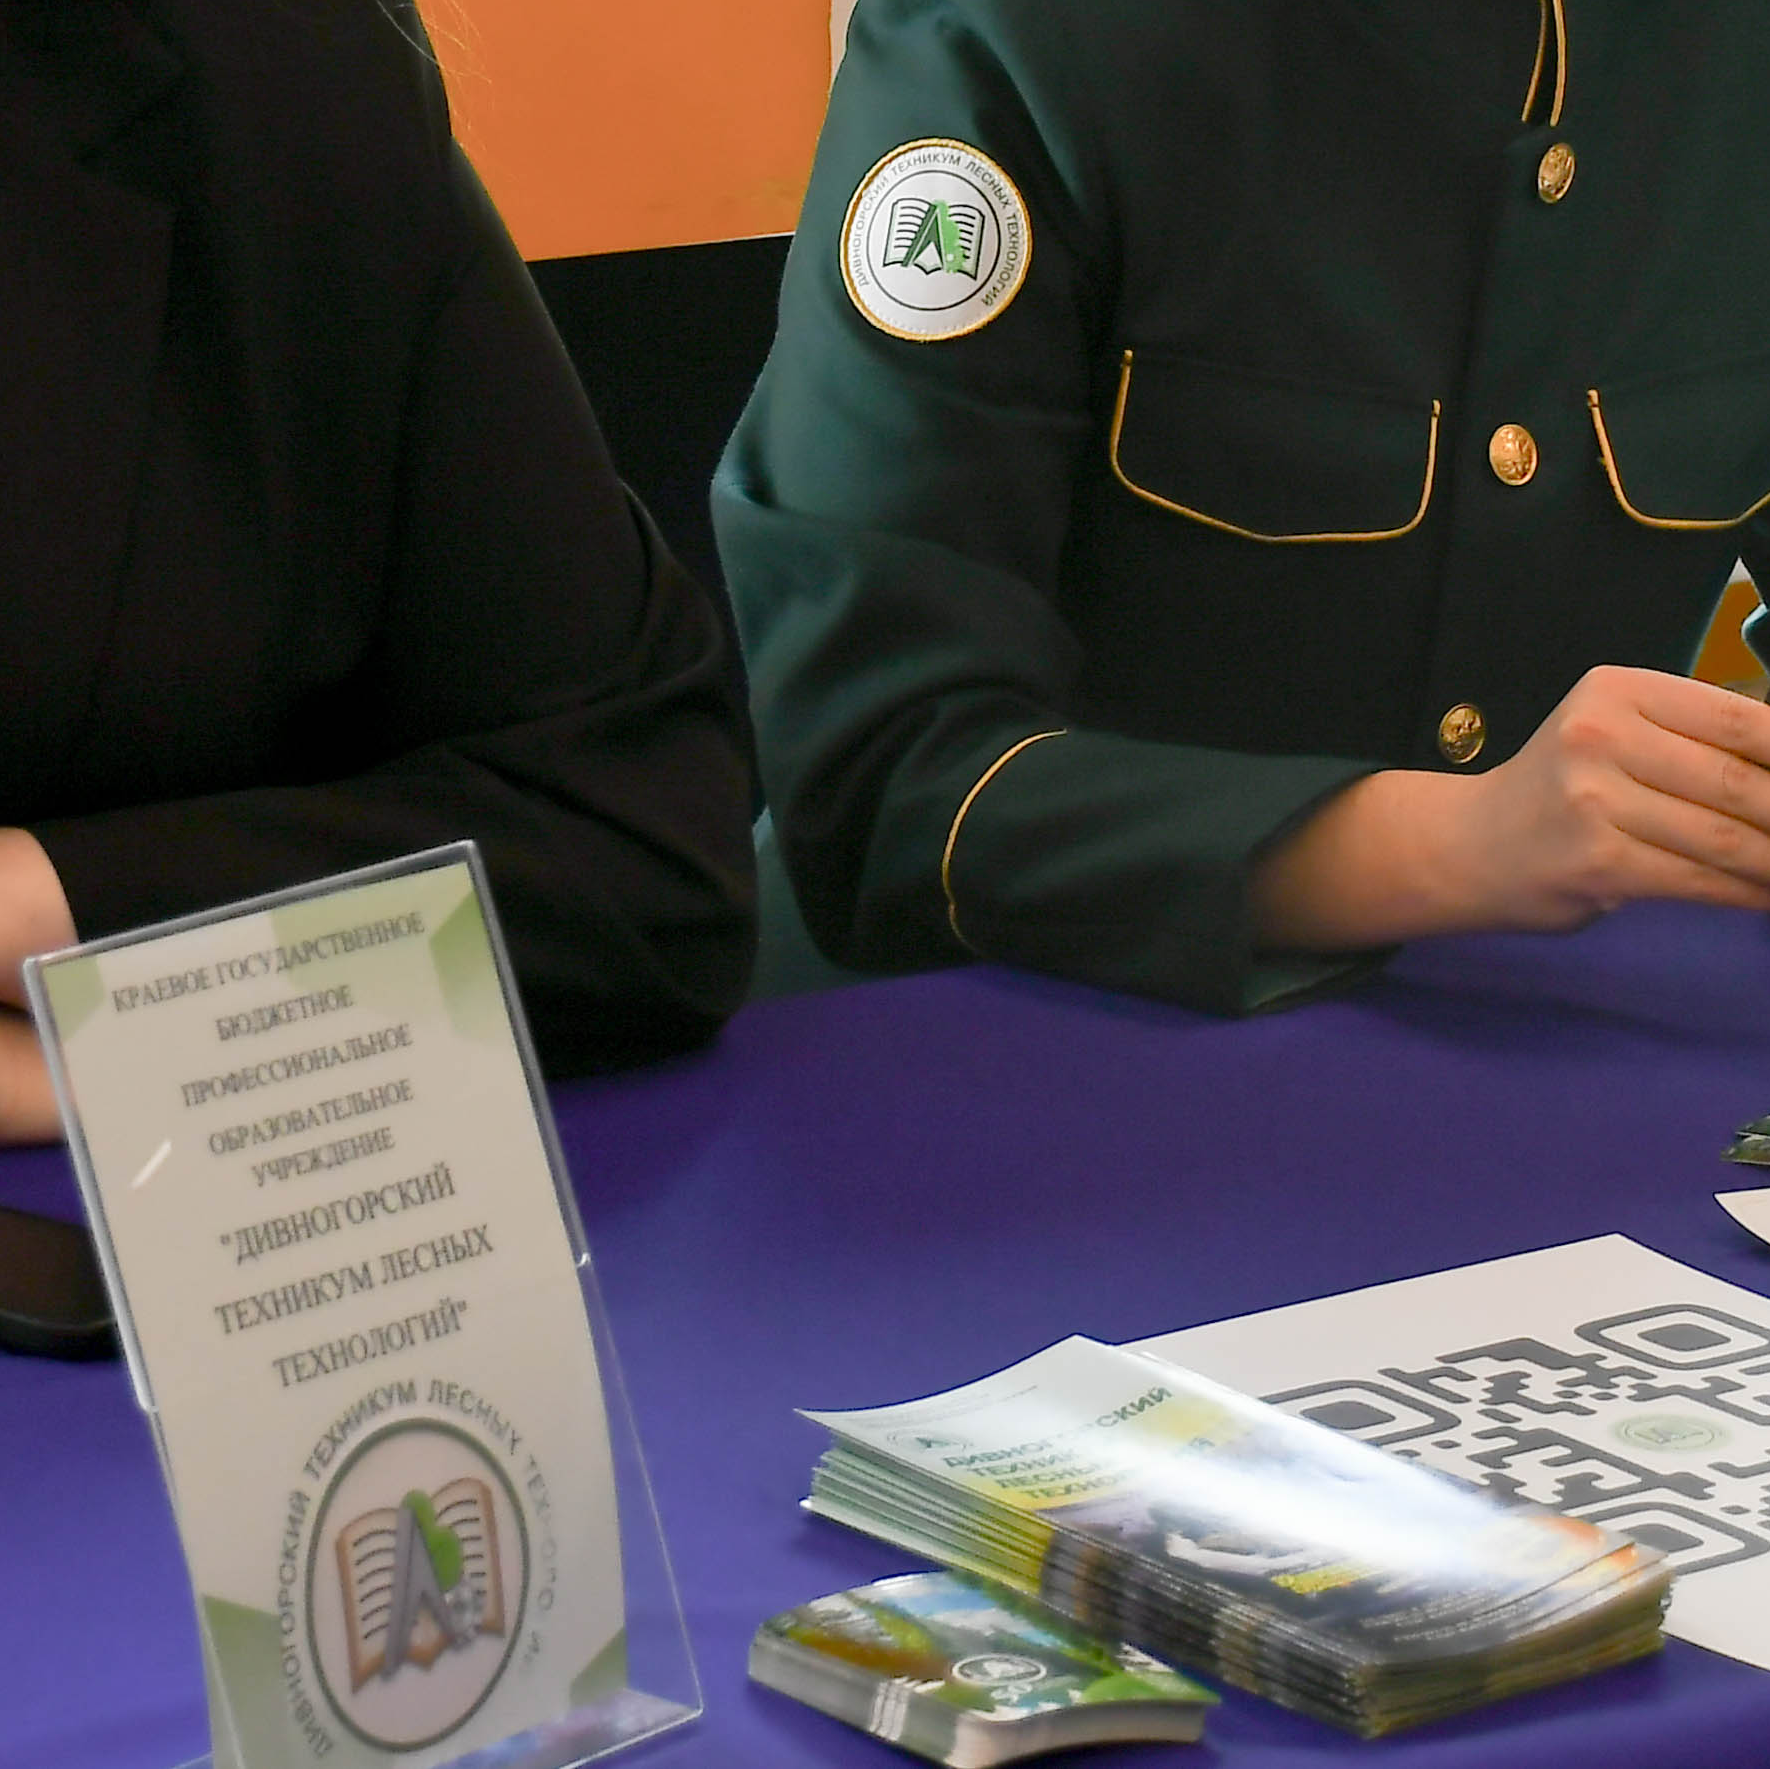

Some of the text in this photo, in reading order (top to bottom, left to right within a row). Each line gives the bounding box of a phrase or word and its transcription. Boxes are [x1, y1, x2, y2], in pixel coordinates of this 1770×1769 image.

[890, 152, 962, 178] ТЕХНИКУМ
[964, 160, 1012, 210] ЛЕСНЫХ
[111, 911, 425, 1013] КРАЕВОЕ ГОСУДАРСТВЕННОЕ
[215, 984, 354, 1042] БЮДЖЕТНОЕ
[181, 1023, 414, 1108] ПРОФЕССИОНАЛЬНОЕ
[208, 1079, 414, 1156] ОБРАЗОВАТЕЛЬНОЕ
[250, 1127, 396, 1190] УЧРЕЖДЕНИЕ
[219, 1162, 457, 1266] "ДИВНОГОРСКИЙ
[214, 1224, 495, 1335] ТЕХНИКУМ ЛЕСНЫХ
[271, 1296, 468, 1388] ТЕХНОЛОГИЙ"
[304, 1379, 418, 1480] ТЕХНИКУМ
[426, 1378, 523, 1456] ЛЕСНЫХ
